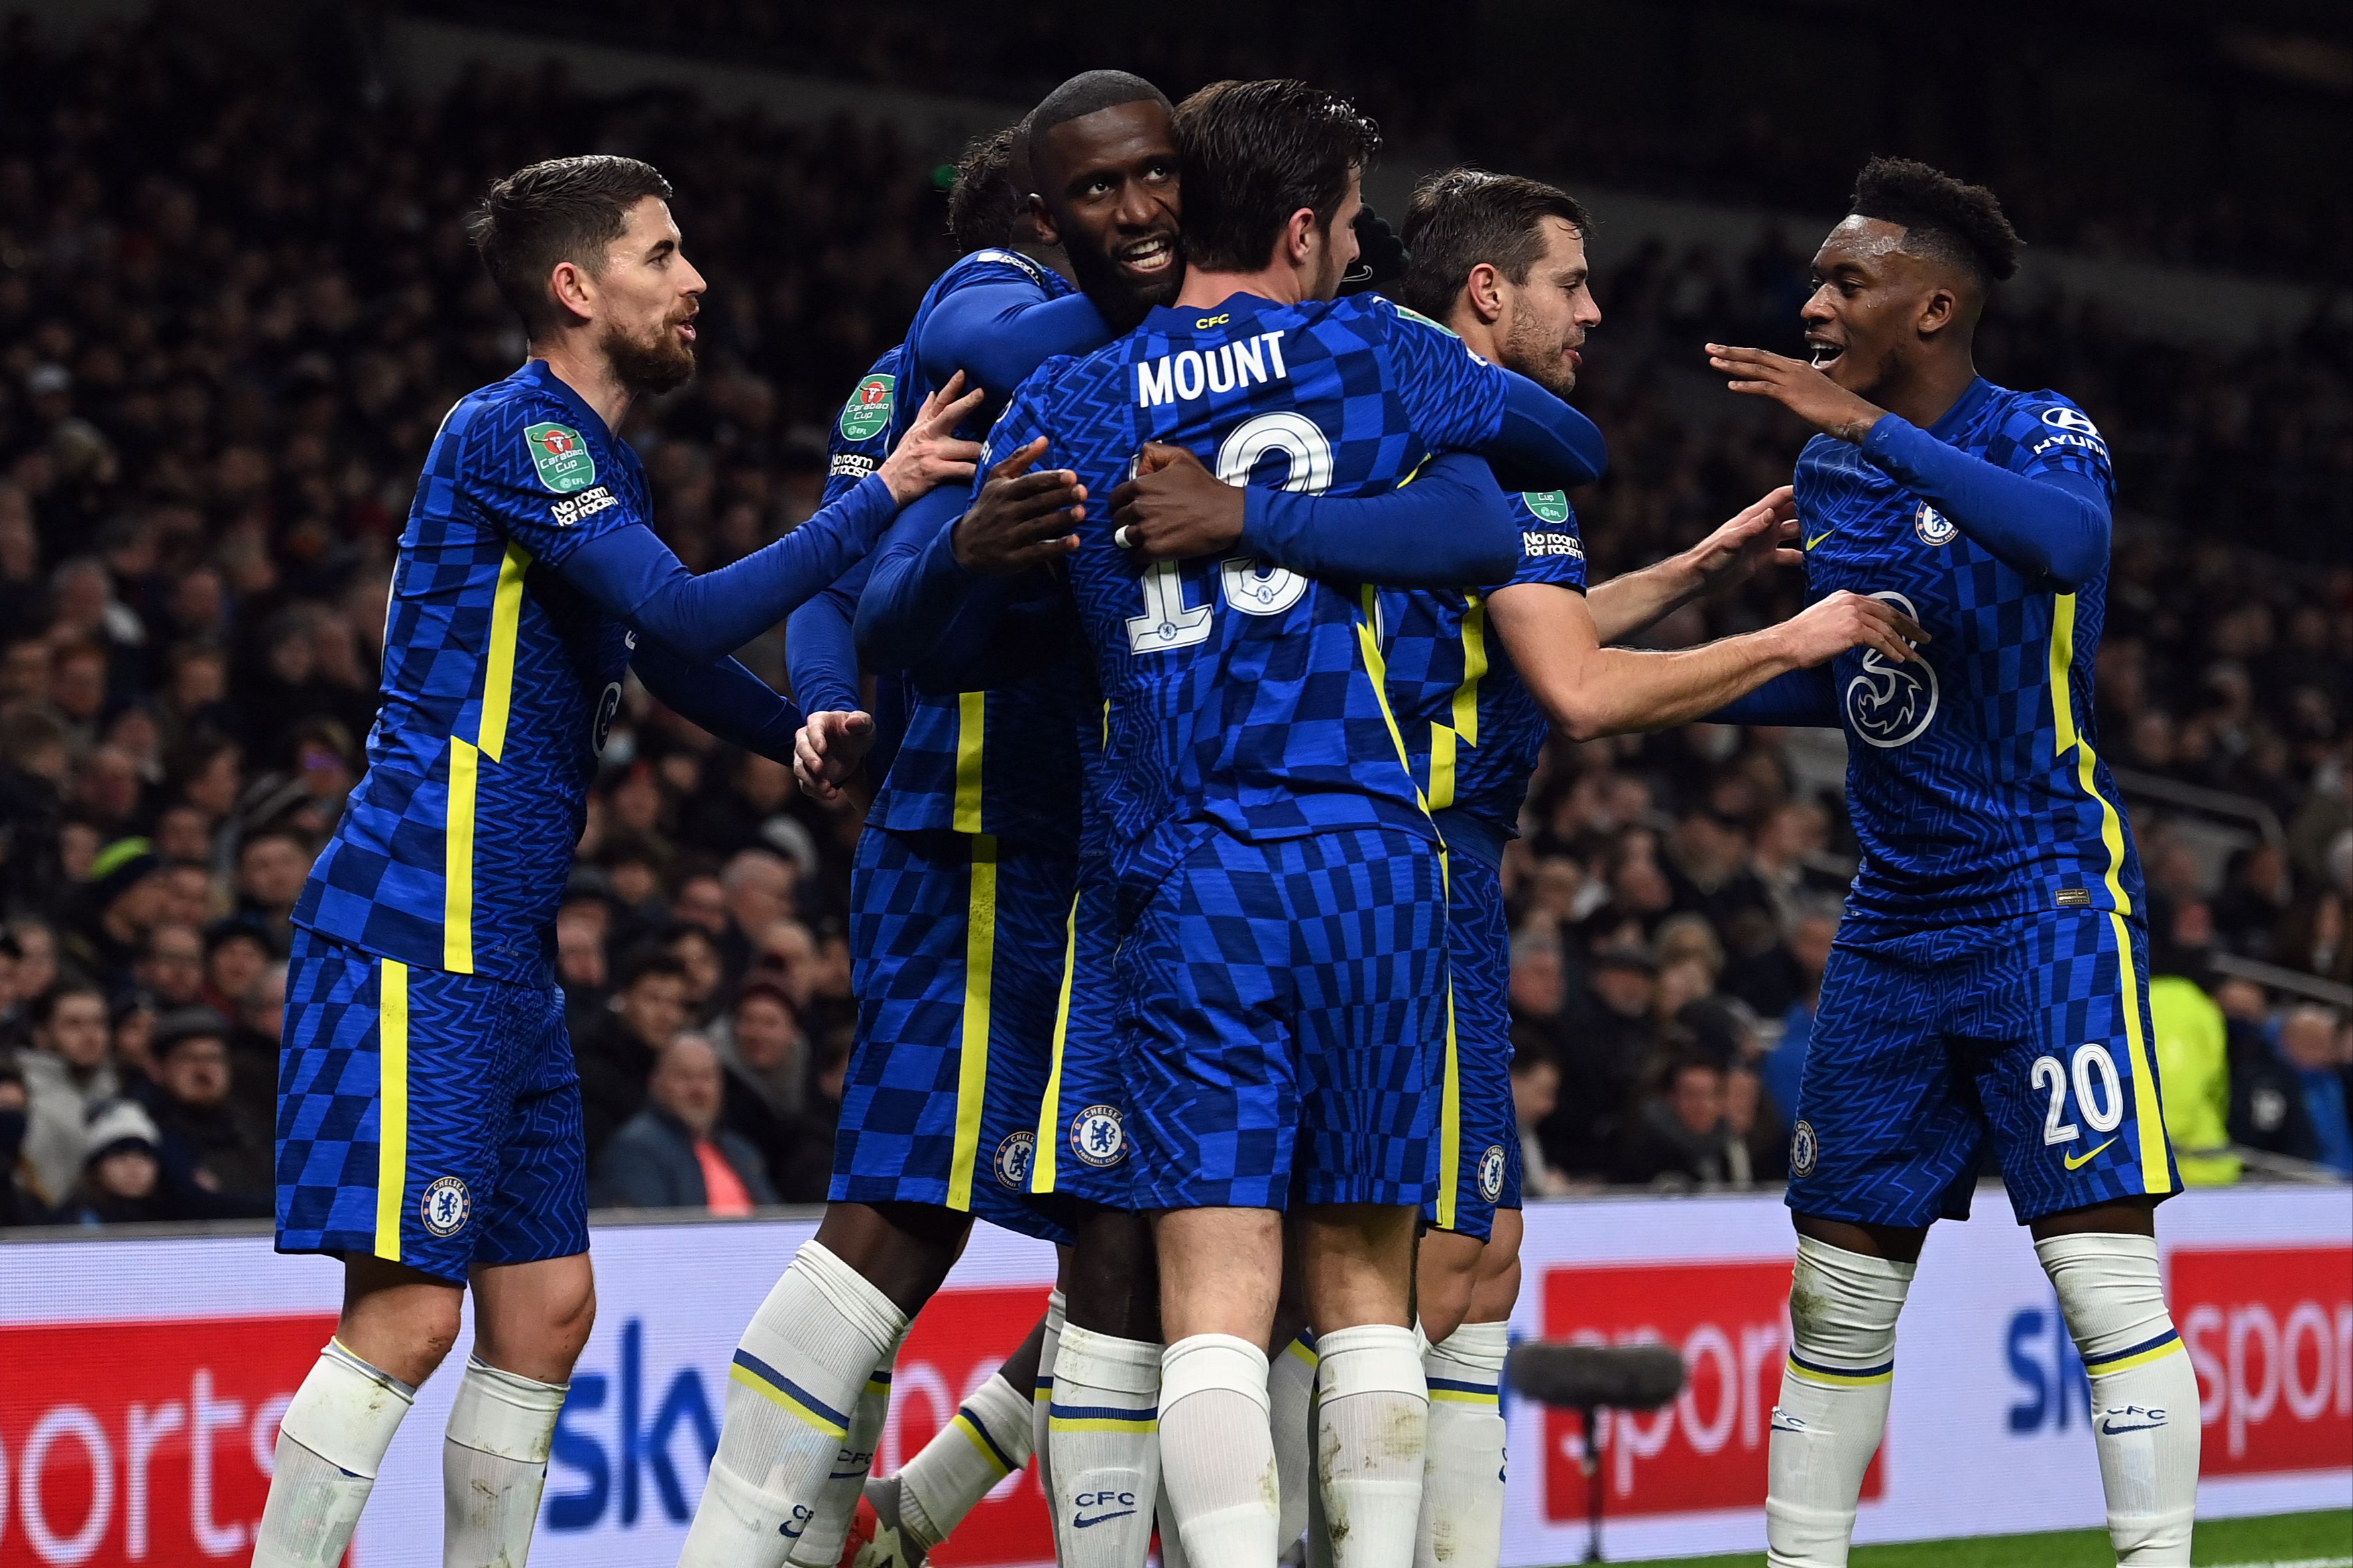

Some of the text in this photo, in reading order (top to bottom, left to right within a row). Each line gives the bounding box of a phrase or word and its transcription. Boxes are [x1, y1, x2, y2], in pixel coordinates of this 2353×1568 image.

[1196, 313, 1230, 329] CFC
[1137, 330, 1287, 408] MOUNT
[847, 403, 889, 413] Carabao
[854, 412, 873, 420] Cup
[539, 448, 584, 469] Carabao
[555, 459, 578, 473] Cup
[841, 455, 874, 469] room
[551, 486, 608, 520] No room
[1537, 493, 1554, 502] Cup
[557, 495, 619, 526] for racism
[1523, 532, 1579, 548] No room
[1525, 544, 1546, 556] for
[2031, 1043, 2124, 1146] 20
[1084, 1107, 1123, 1124] CHELSEA
[1011, 1134, 1035, 1143] CHELS
[1078, 1150, 1118, 1164] FOOTBALL CLUB
[433, 1179, 465, 1194] CHELSEA
[1075, 1492, 1135, 1507] CFC
[792, 1504, 815, 1524] CF
